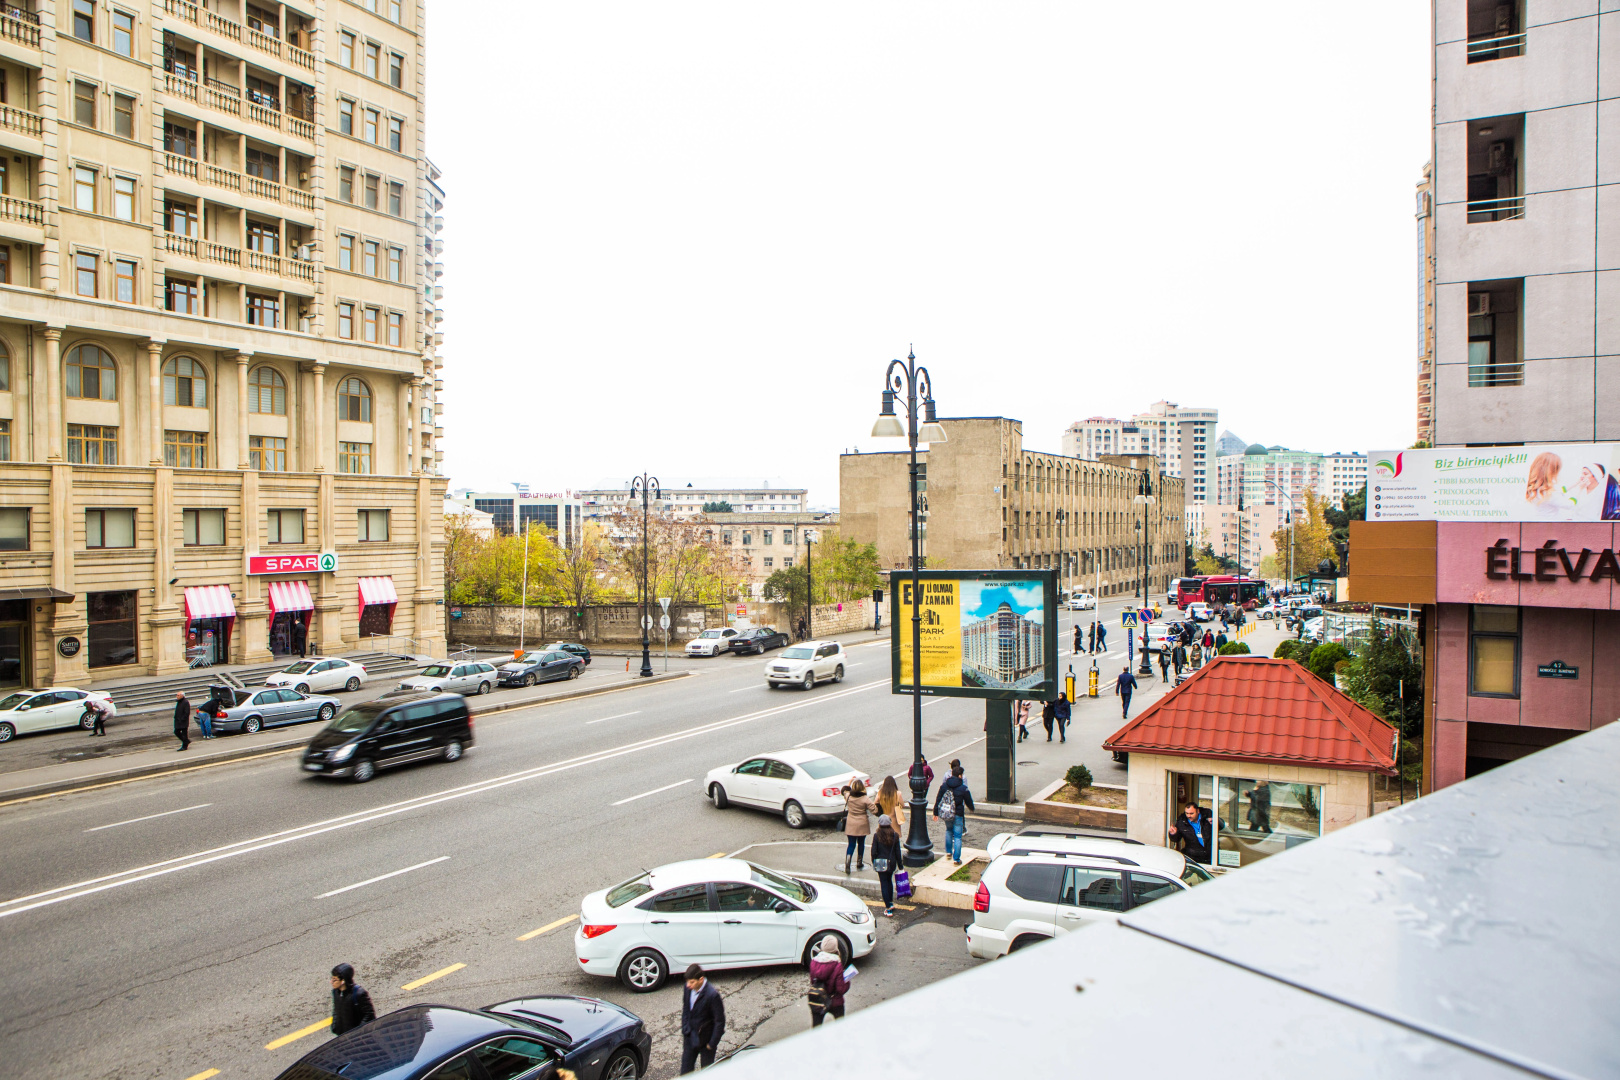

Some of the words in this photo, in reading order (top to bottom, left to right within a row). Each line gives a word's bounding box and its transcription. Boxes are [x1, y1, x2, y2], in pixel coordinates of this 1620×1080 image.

[1435, 459, 1454, 469] Biz
[266, 557, 318, 570] SPAR
[1486, 538, 1620, 583] ÉLÉVA
[925, 595, 954, 606] ZAMANI
